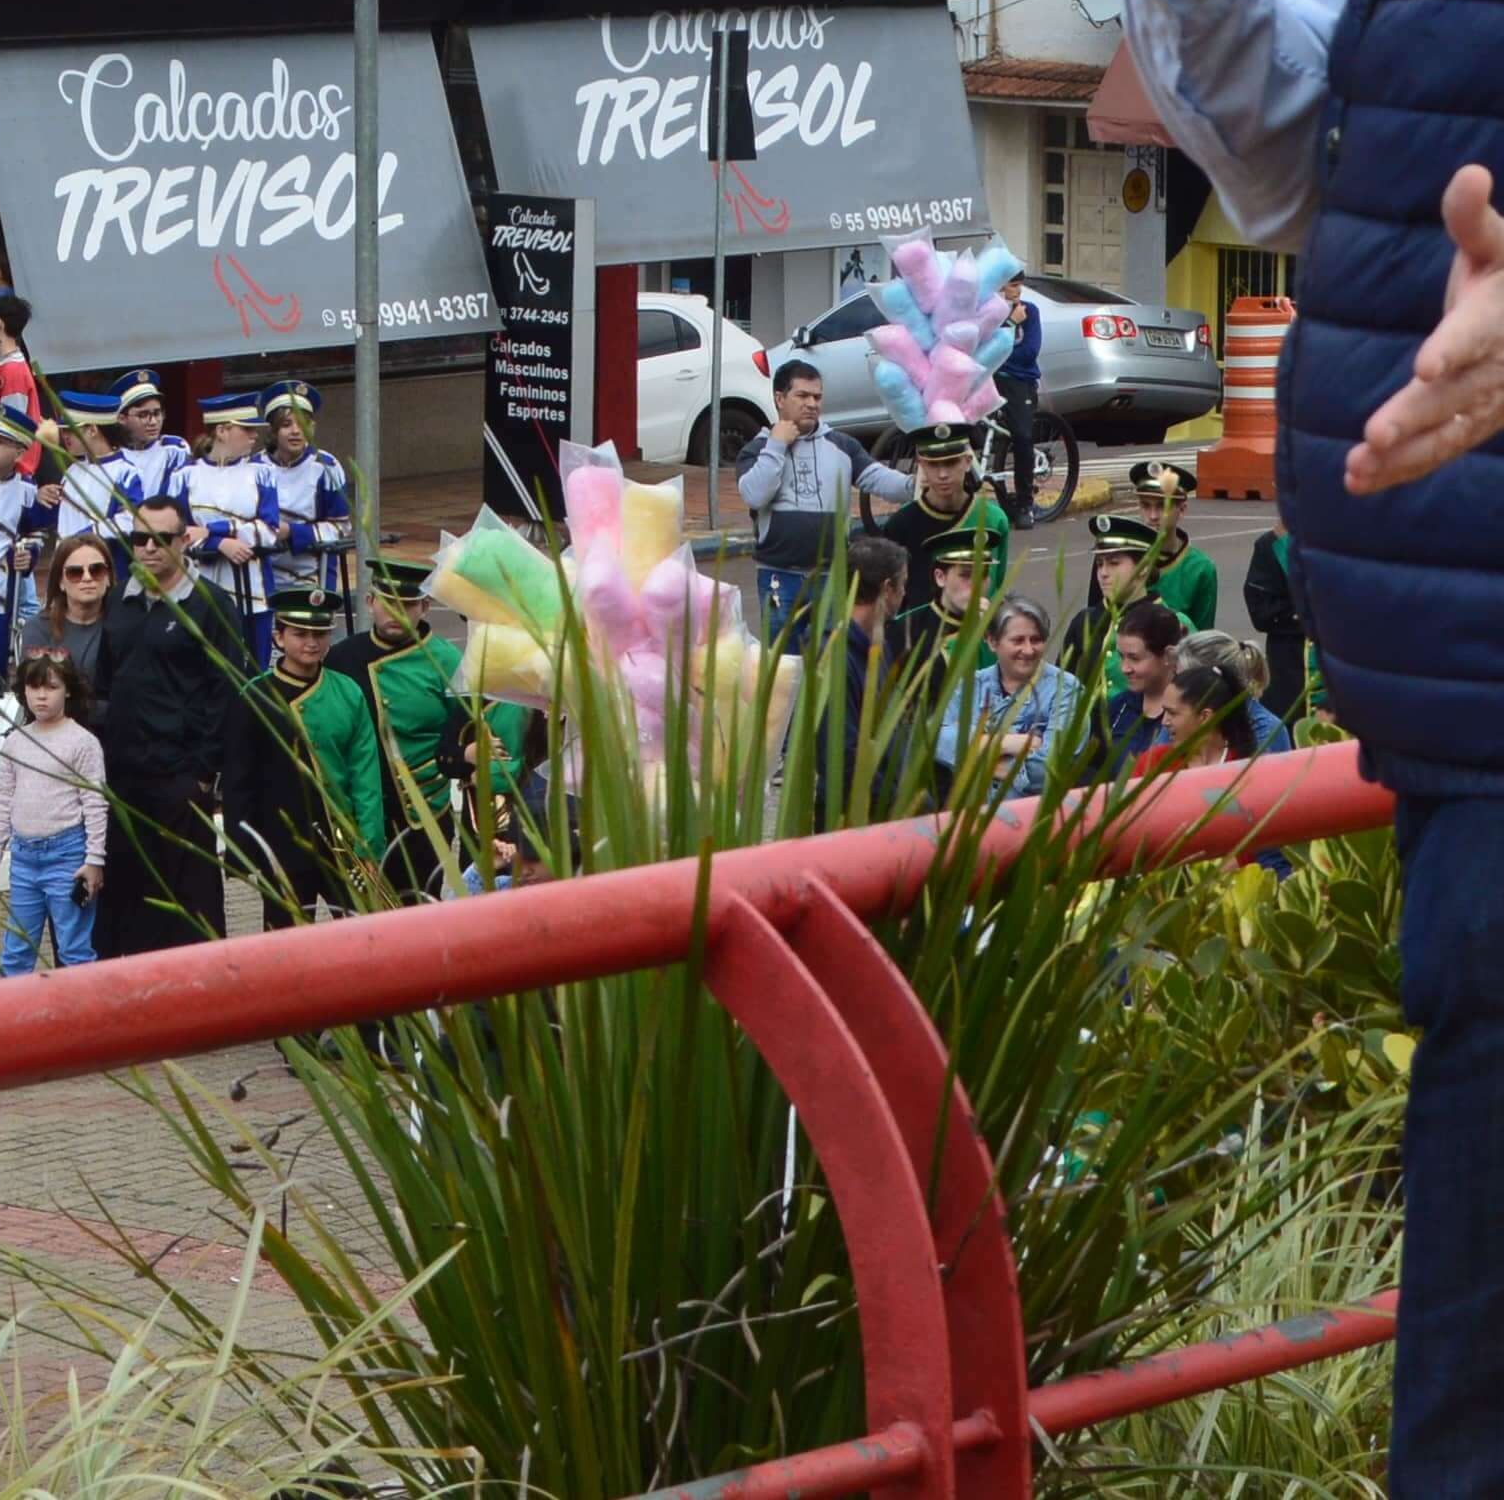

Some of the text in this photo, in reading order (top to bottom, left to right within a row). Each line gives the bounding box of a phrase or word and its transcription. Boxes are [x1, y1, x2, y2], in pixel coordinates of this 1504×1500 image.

[58, 52, 351, 162] Calçados
[575, 61, 877, 166] TRESOL
[54, 151, 404, 263] TREVISOL
[846, 197, 974, 232] 55 99941-8367
[492, 224, 574, 252] TREVISOL
[379, 292, 489, 328] 9941-8367
[509, 306, 569, 325] 3744-2945
[489, 338, 552, 359] Calçados
[495, 359, 569, 380] Masculinos
[500, 381, 567, 402] Femininos
[507, 402, 566, 422] Esportes
